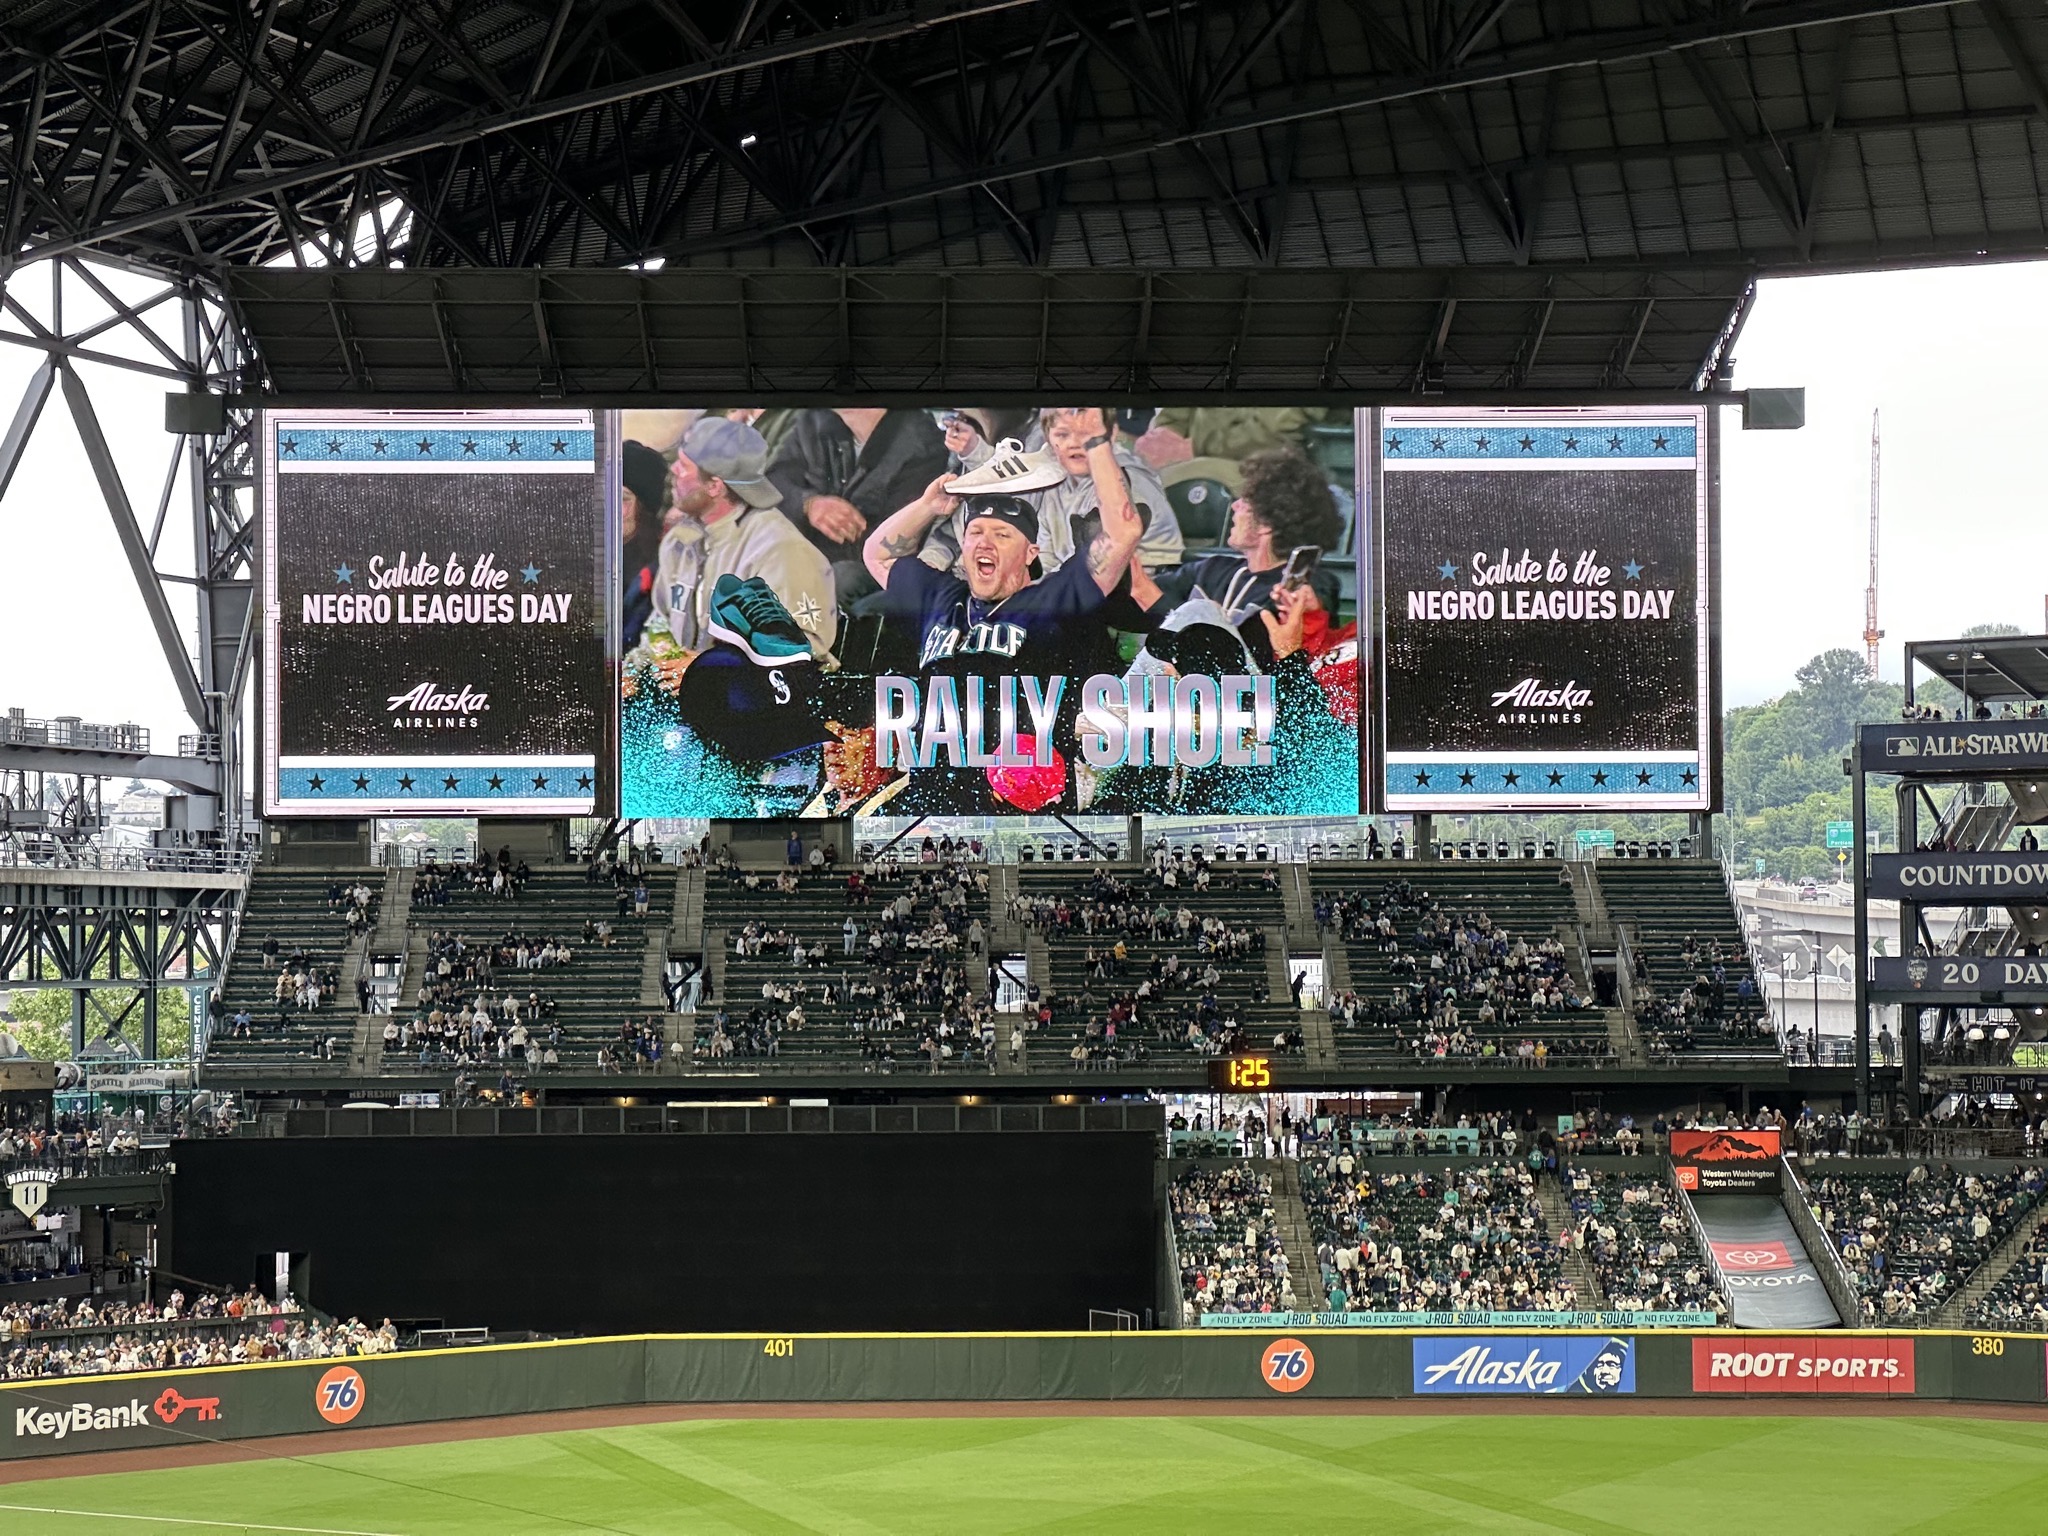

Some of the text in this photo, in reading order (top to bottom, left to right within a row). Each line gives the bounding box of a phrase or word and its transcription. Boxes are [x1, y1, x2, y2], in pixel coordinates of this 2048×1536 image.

[368, 551, 509, 590] Salute to the
[1472, 548, 1611, 587] Salute to the
[302, 593, 573, 624] NEGRO LEAGUES DAY
[1408, 590, 1675, 620] NEGRO LEAGUES DAY
[387, 682, 489, 714] Alaska
[1491, 678, 1591, 710] Alaska
[393, 717, 478, 728] AIRLINES
[874, 673, 1278, 768] RALLY SHOE!
[1498, 713, 1582, 724] AIRLINES
[1943, 963, 1980, 984] 20
[193, 994, 202, 1053] CENTER
[1231, 1059, 1270, 1087] 1:25
[7, 1170, 58, 1186] MARTINEZ
[1702, 1169, 1775, 1179] Western Washington
[1702, 1179, 1755, 1188] Toyota Dealers
[24, 1186, 38, 1205] 11
[1726, 1273, 1815, 1287] OYOTA
[1217, 1316, 1230, 1324] NO
[1249, 1315, 1272, 1323] ZONE
[1315, 1313, 1348, 1325] SQUAD
[1359, 1315, 1372, 1323] NO
[1374, 1315, 1389, 1323] FLY
[1391, 1315, 1414, 1323] ZONE
[1457, 1312, 1490, 1324] SQUAD
[1601, 1312, 1633, 1324] SQUAD
[764, 1339, 793, 1357] 401
[1972, 1337, 2004, 1356] 380
[1269, 1348, 1308, 1380] 76
[1424, 1346, 1562, 1390] Alaska
[1711, 1352, 1899, 1378] ROOT SPORTS
[322, 1376, 358, 1410] 76
[16, 1398, 149, 1439] KeyBank
